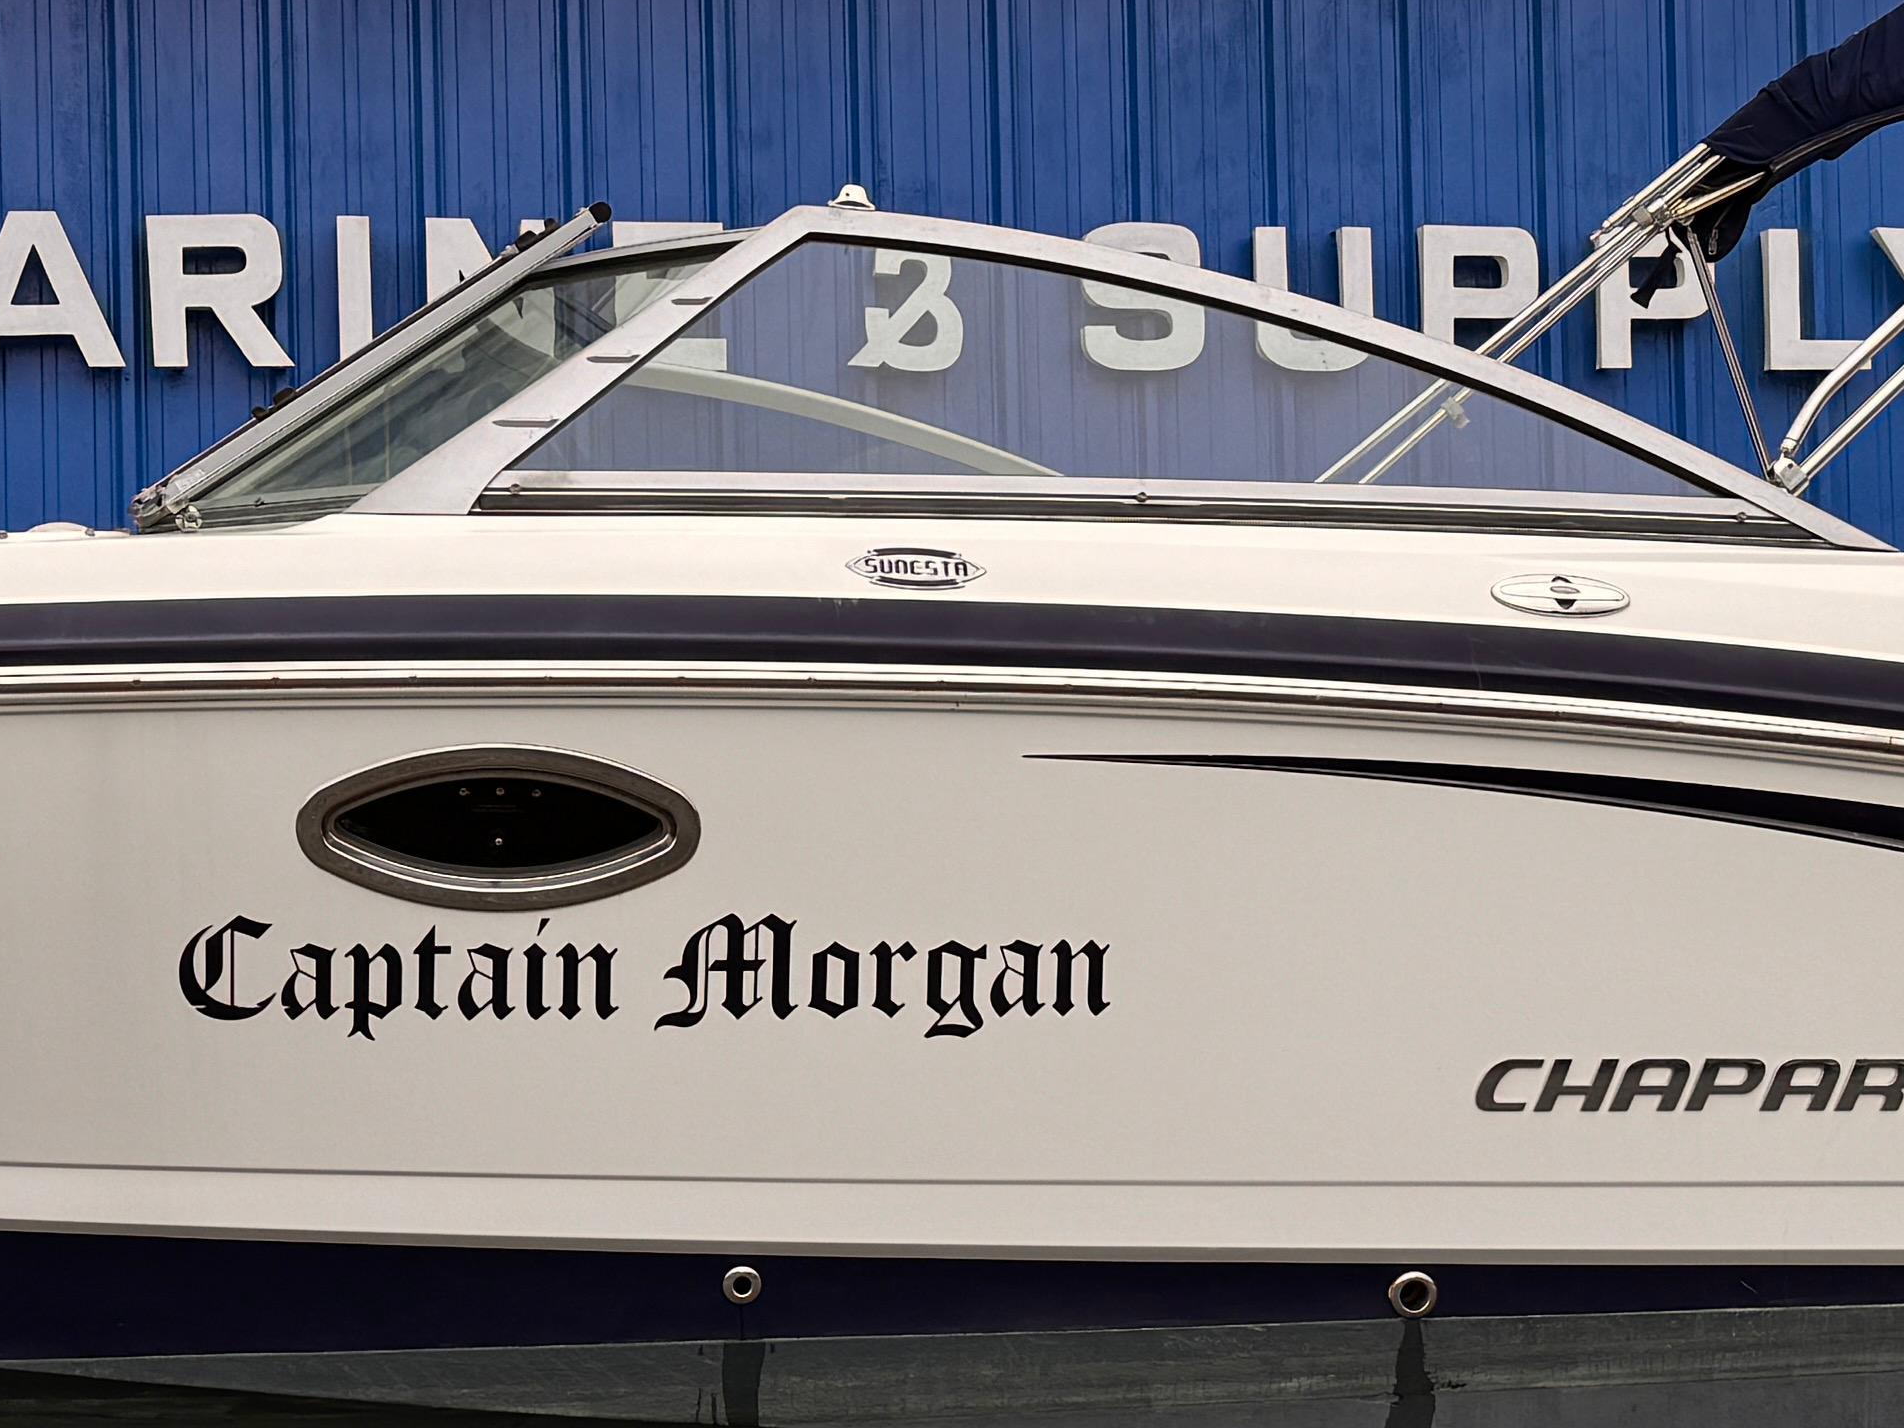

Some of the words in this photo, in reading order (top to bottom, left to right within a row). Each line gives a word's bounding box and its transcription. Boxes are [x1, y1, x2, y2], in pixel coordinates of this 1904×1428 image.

[864, 557, 969, 578] SUNESTA
[179, 915, 619, 1041] Captain
[654, 912, 1111, 1039] Morgan
